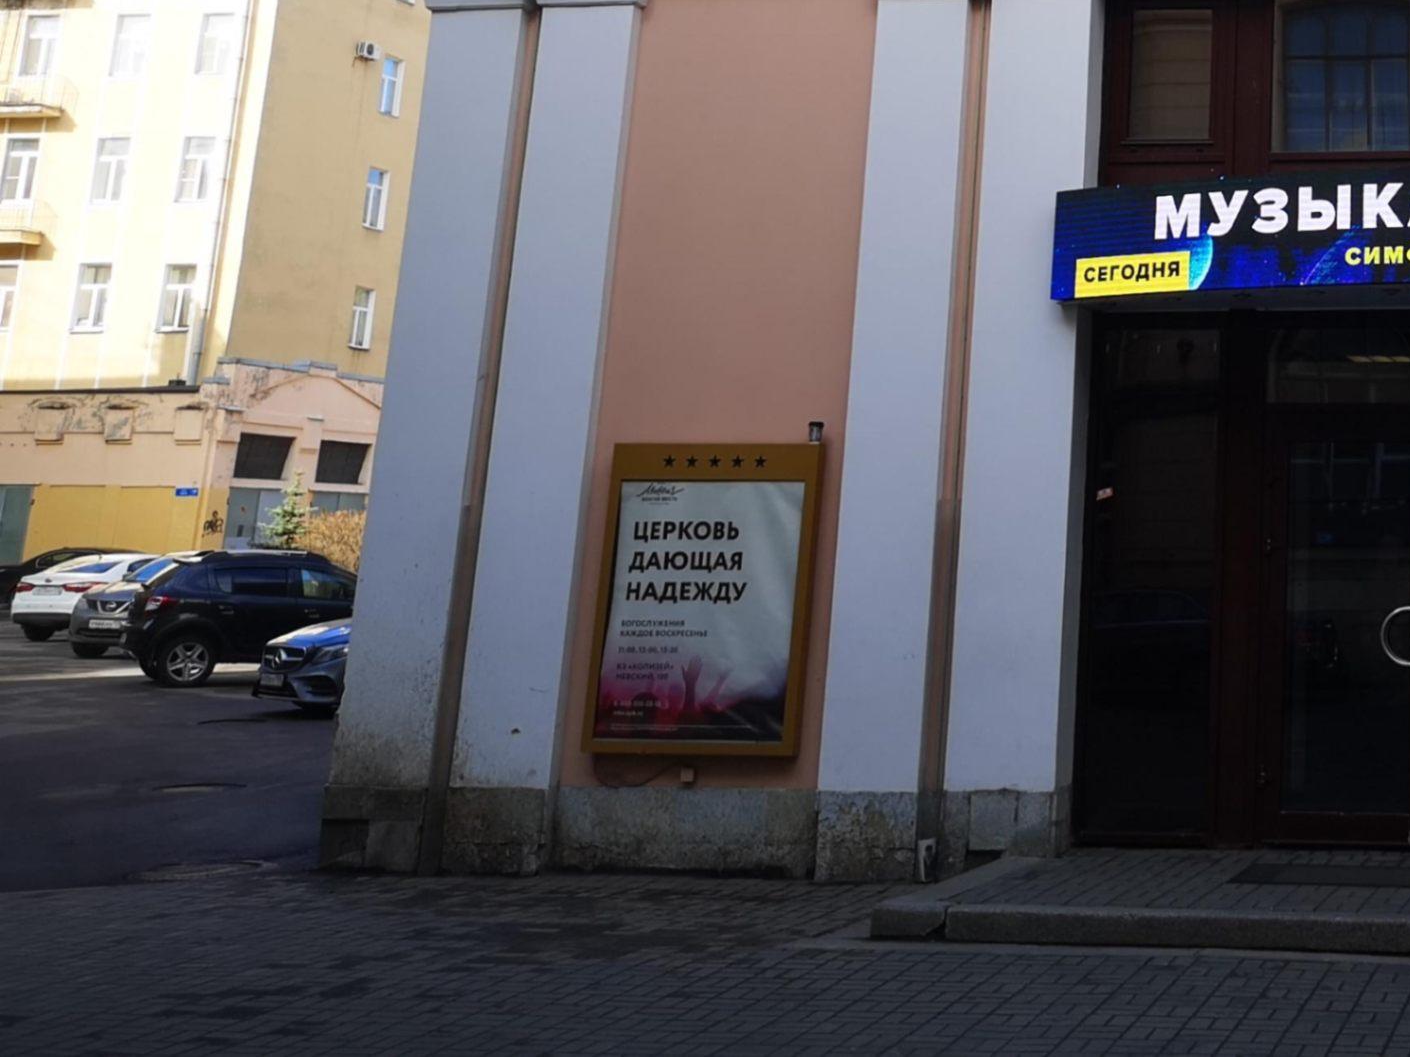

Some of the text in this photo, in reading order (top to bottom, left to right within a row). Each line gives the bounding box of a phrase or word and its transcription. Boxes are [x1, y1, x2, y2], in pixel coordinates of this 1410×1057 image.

[1082, 259, 1182, 284] СЕГОДНЯ
[633, 520, 740, 543] ЦЕРКОВЬ
[628, 550, 744, 573] ДАЮЩАЯ
[625, 580, 748, 604] НАДЕЖДУ
[620, 629, 708, 638] КАЖДОЕ ВОСКРЕСЕНЬЕ
[621, 619, 685, 628] БОГОСЛУЖЕНИЯ
